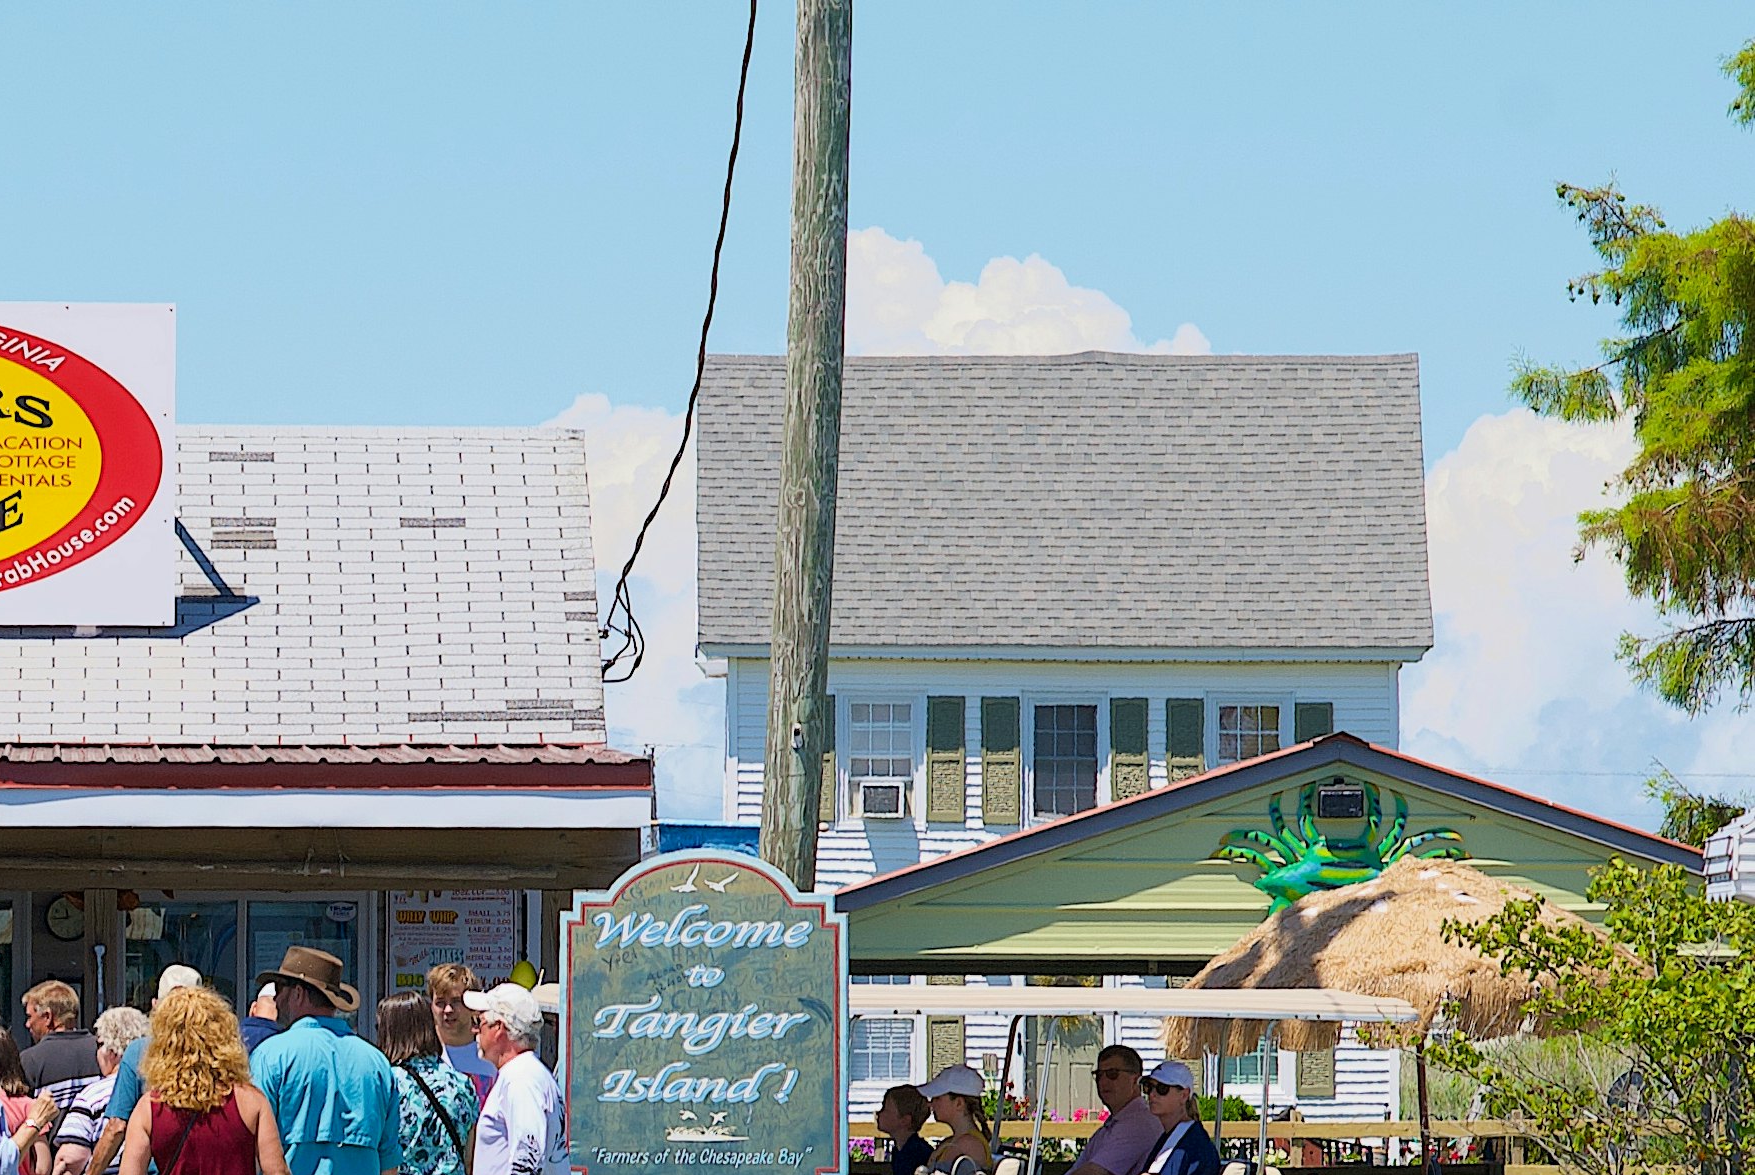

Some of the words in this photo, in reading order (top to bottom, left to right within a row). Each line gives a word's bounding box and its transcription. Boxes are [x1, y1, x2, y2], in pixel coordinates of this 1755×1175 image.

[593, 903, 813, 949] Welcome
[684, 961, 726, 988] to
[592, 994, 811, 1055] Tangier
[656, 1149, 670, 1164] of
[675, 1149, 696, 1164] the
[699, 1149, 773, 1168] Chesapeake
